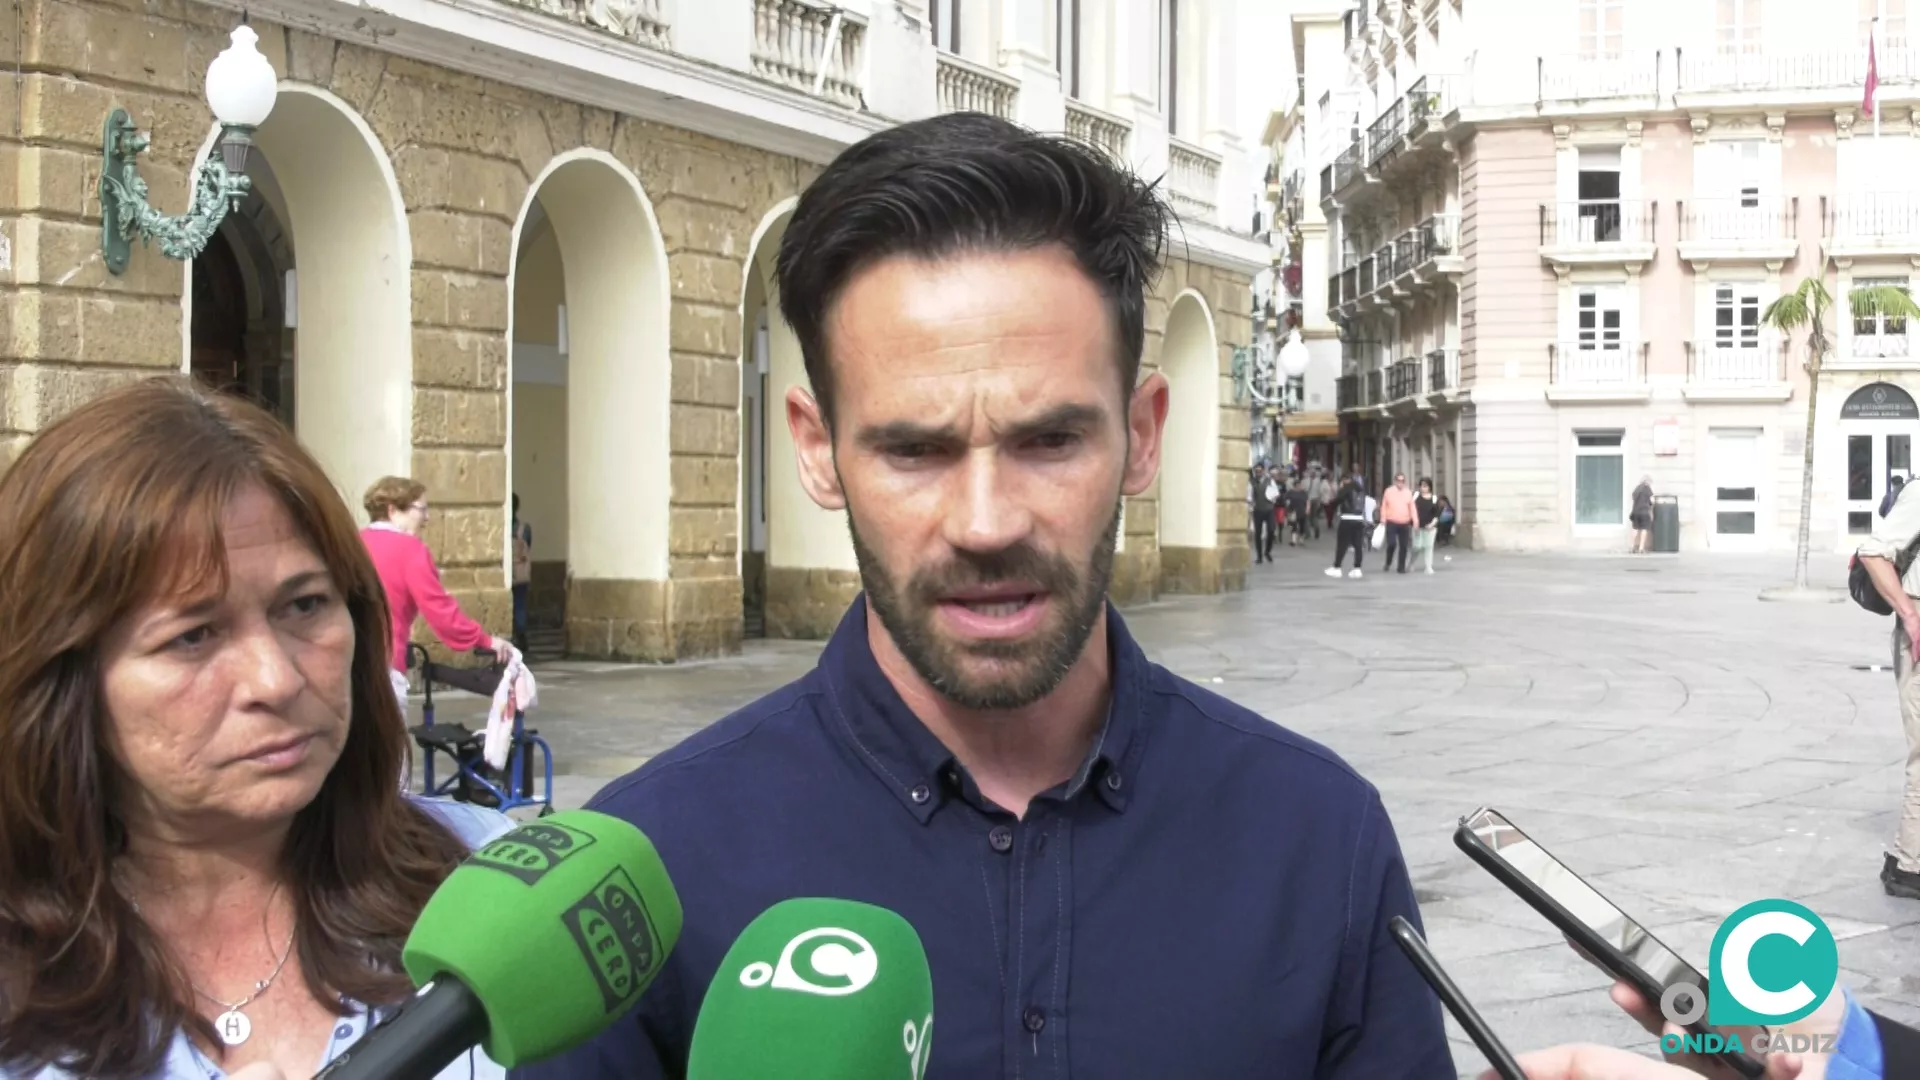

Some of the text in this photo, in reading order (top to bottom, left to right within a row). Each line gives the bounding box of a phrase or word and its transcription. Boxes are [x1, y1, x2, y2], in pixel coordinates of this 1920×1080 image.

[482, 841, 541, 867] CERO
[588, 917, 628, 988] CERO
[611, 891, 650, 966] ONDA
[225, 1017, 241, 1037] H
